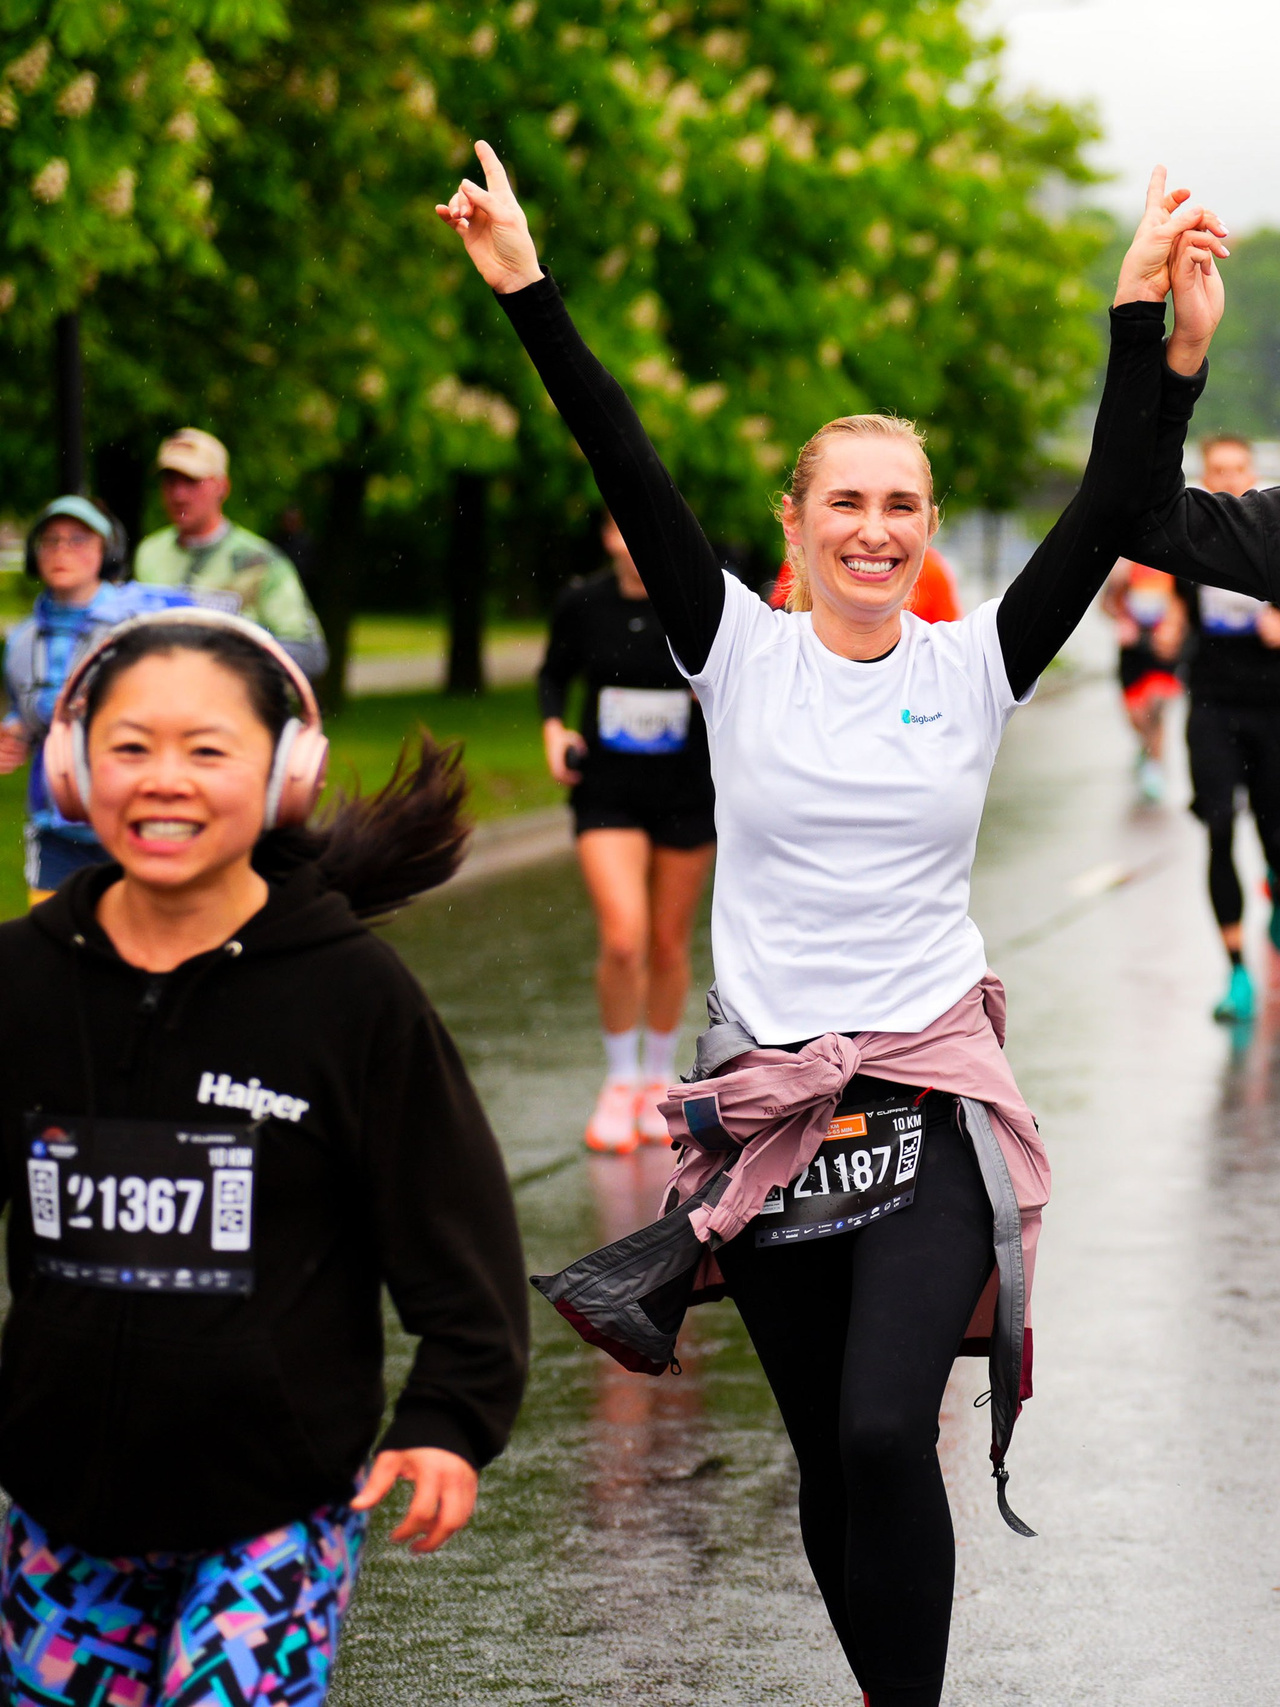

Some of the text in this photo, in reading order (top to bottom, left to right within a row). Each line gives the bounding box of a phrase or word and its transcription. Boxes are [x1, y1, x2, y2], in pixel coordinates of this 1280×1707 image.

[911, 711, 943, 725] Bigbank
[197, 1071, 310, 1122] Haiper
[876, 1106, 909, 1117] CUPRA
[892, 1114, 923, 1132] 10 KM
[208, 1148, 253, 1168] 10 KM
[793, 1145, 892, 1199] 21187
[67, 1173, 205, 1235] 21367
